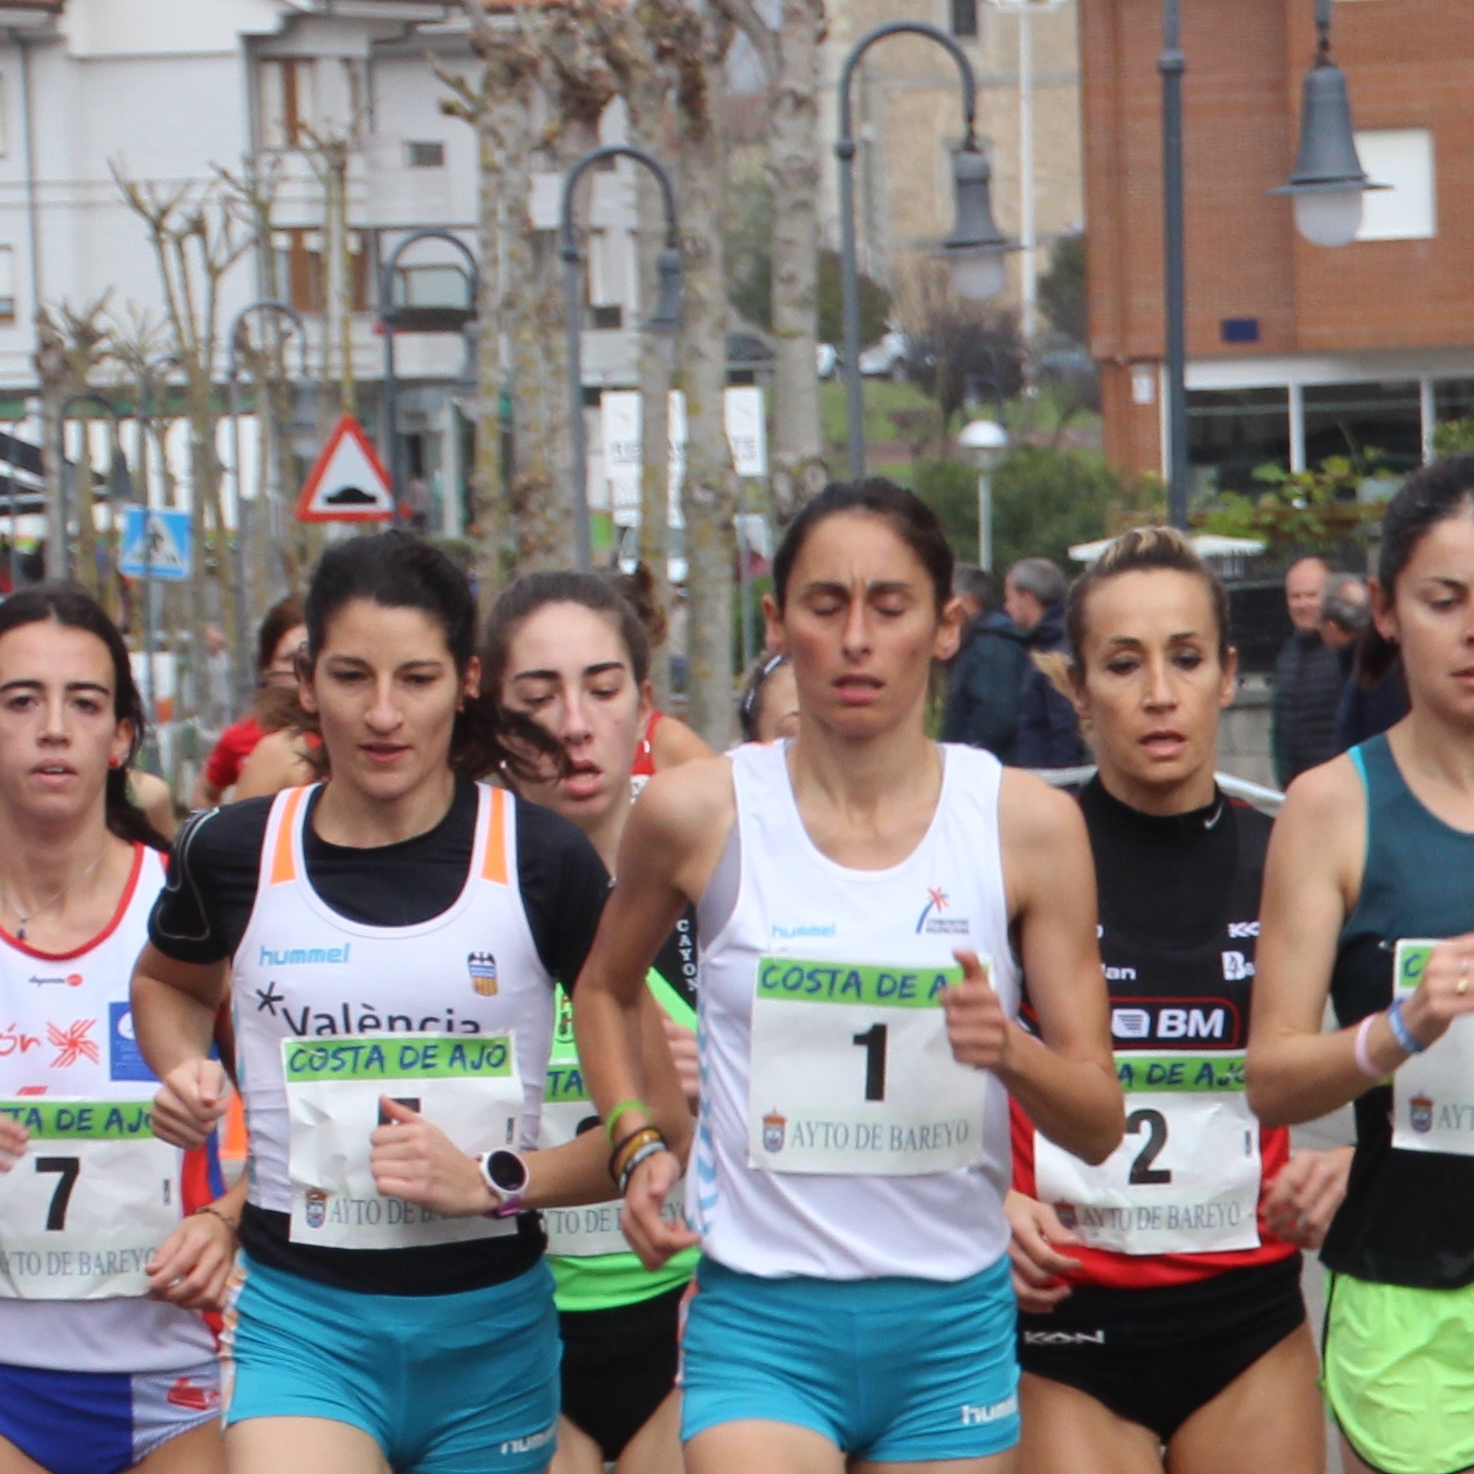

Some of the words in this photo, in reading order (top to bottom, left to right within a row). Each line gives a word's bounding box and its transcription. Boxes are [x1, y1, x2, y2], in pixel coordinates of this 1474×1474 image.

[771, 922, 836, 938] hummel
[258, 942, 351, 966] hummel
[761, 964, 862, 1000] COSTA
[876, 973, 917, 999] DE
[282, 1002, 481, 1036] València
[1156, 1008, 1225, 1039] BM
[289, 1044, 386, 1075] COSTA
[398, 1043, 440, 1071] DE
[449, 1042, 507, 1072] AJO
[852, 1023, 888, 1102] 1
[1145, 1062, 1185, 1085] DE
[54, 1107, 95, 1133] DE
[790, 1120, 849, 1150] AYTO
[855, 1121, 884, 1150] DE
[889, 1118, 969, 1151] BAREYO
[1125, 1108, 1172, 1185] 2
[35, 1156, 80, 1231] 7
[387, 1198, 416, 1225] DE
[541, 1210, 580, 1235] YTO
[585, 1208, 610, 1234] DE
[1136, 1206, 1162, 1231] DE
[1166, 1201, 1241, 1230] BAREYO
[46, 1251, 75, 1277] DE
